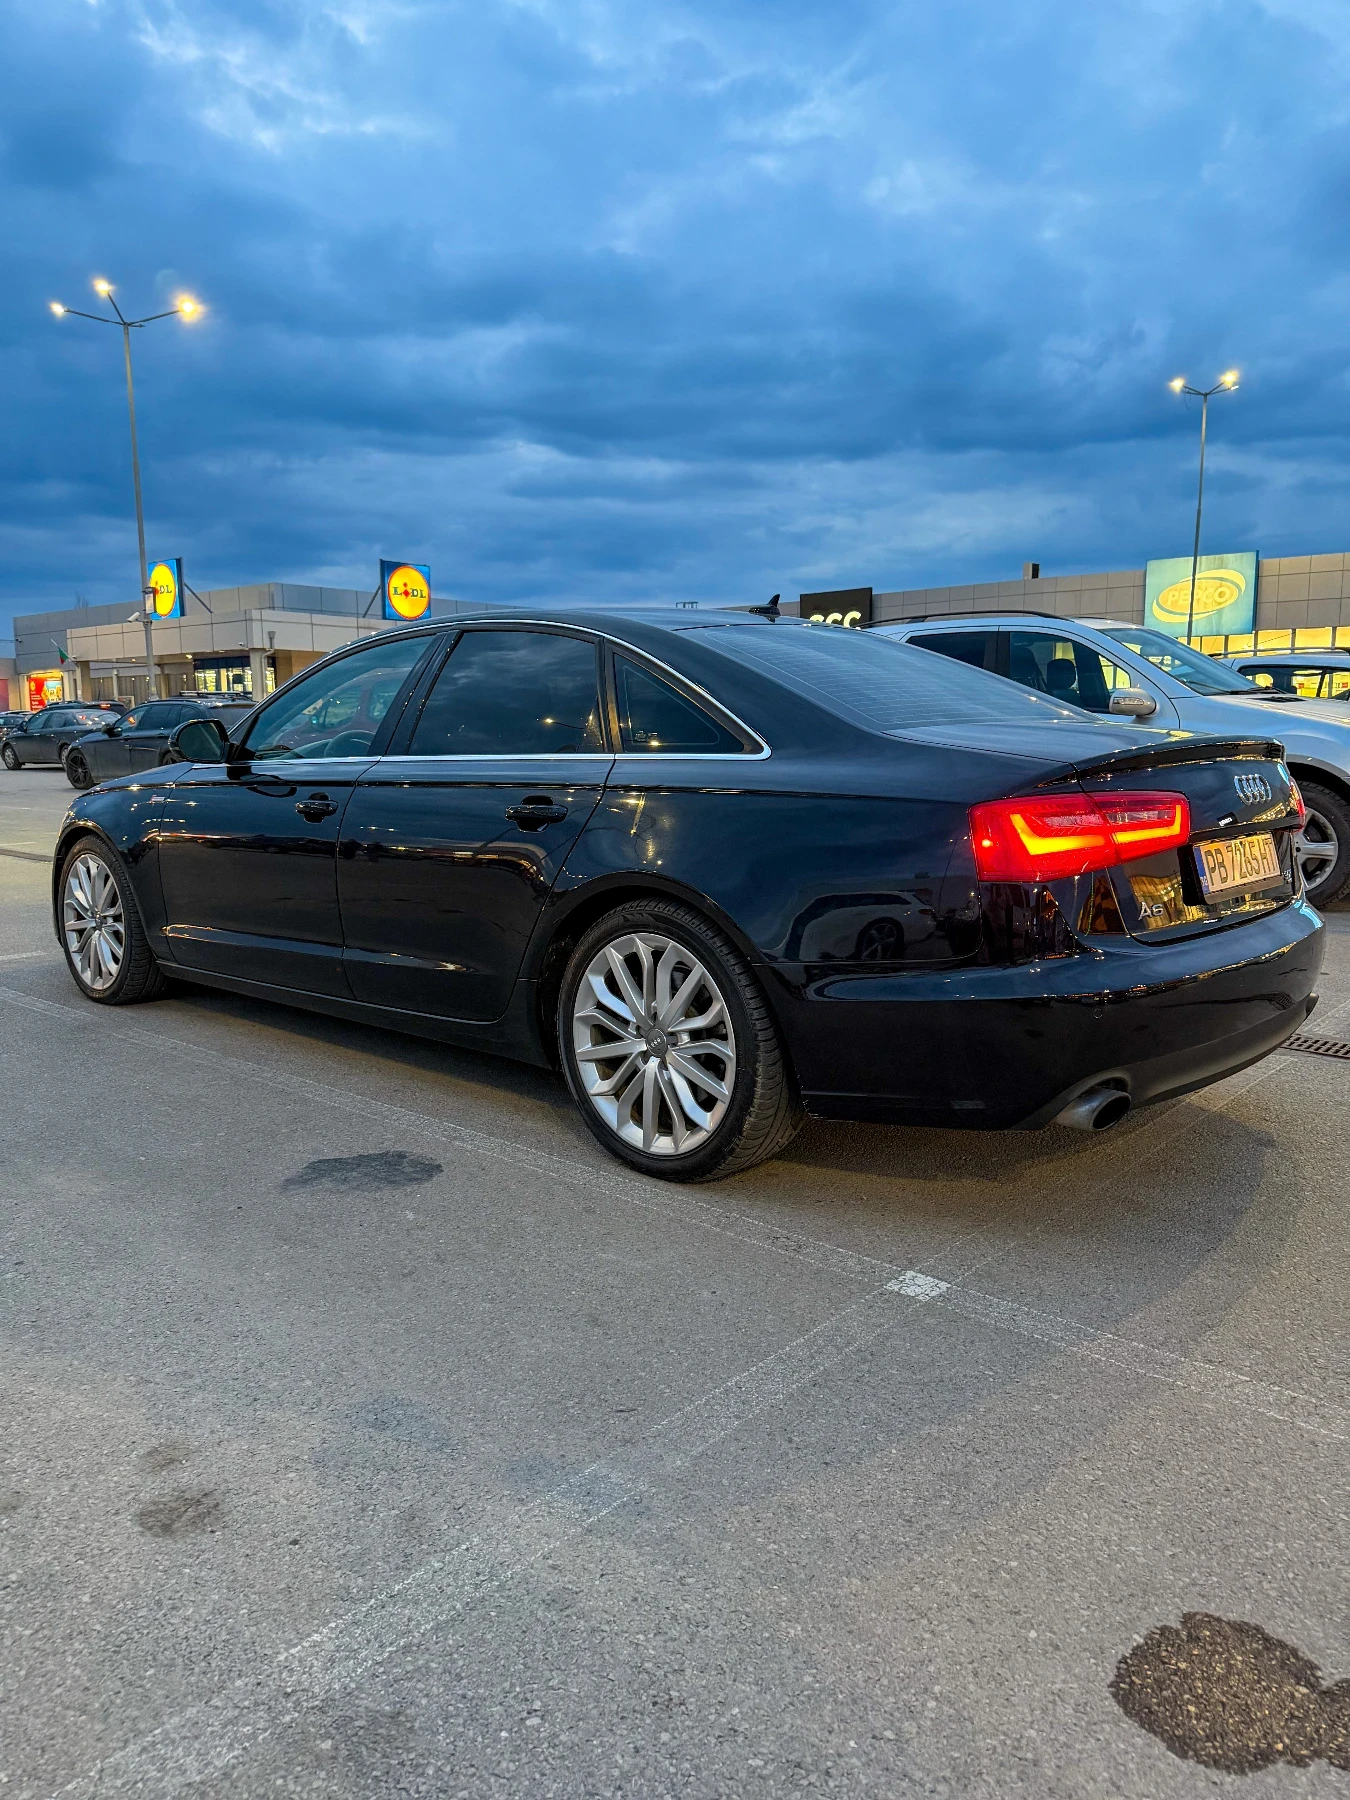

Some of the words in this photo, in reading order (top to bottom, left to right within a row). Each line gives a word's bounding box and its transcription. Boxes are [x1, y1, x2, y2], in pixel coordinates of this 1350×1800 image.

[1204, 847, 1228, 886] PB
[1225, 840, 1261, 882] 7265
[1137, 901, 1165, 921] A6
